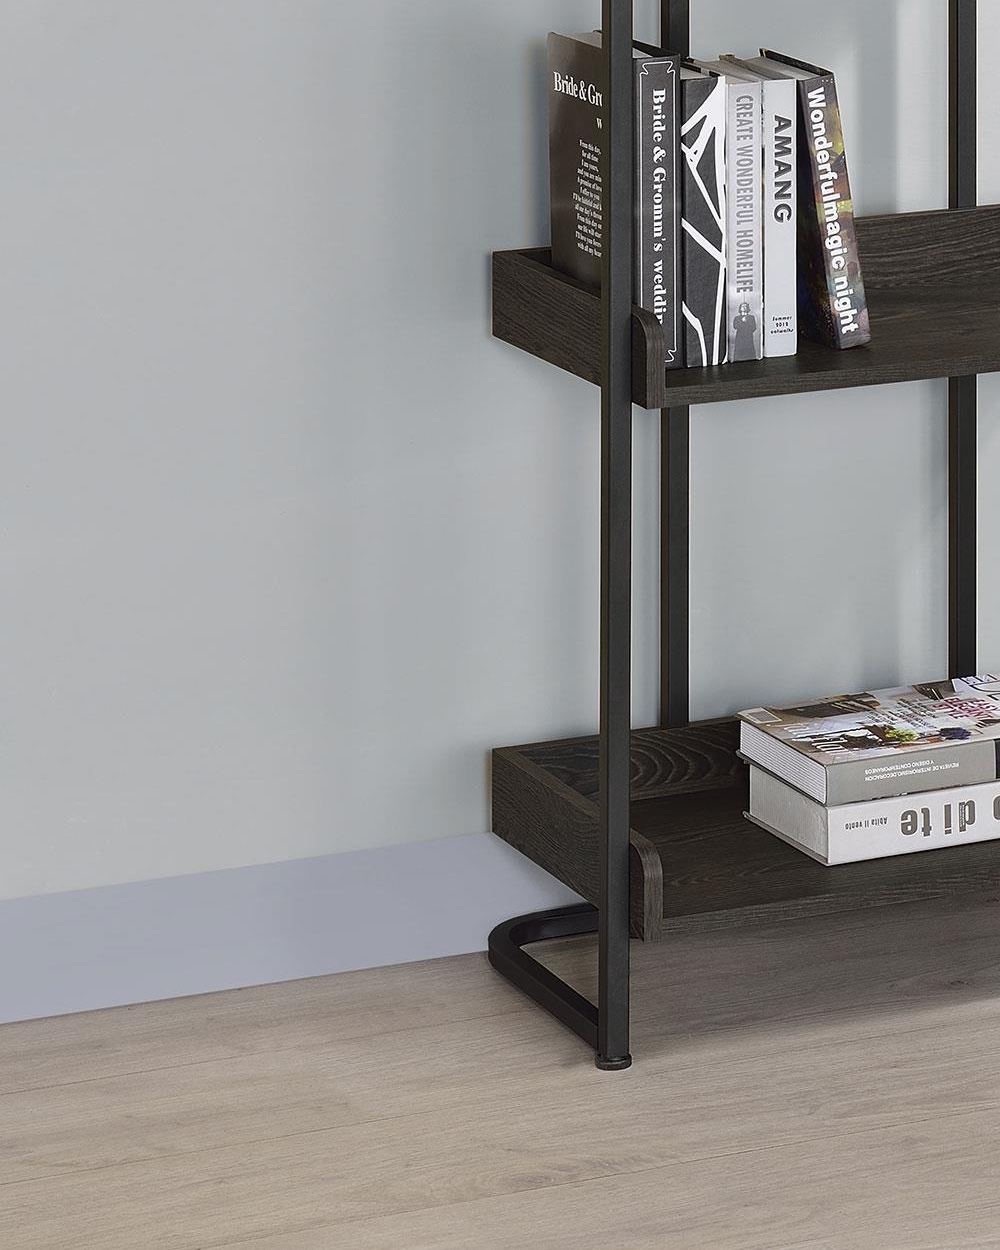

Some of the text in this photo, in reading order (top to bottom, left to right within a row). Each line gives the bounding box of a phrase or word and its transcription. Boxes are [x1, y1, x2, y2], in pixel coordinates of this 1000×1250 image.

[553, 70, 578, 97] Bride
[579, 80, 587, 101] &
[653, 88, 666, 142] Bride
[652, 146, 666, 163] &
[773, 115, 792, 223] AMANG
[652, 166, 667, 252] Gromm's
[736, 95, 754, 293] CREATE WONDERFUL HOMELIFE
[833, 274, 859, 334] night
[845, 819, 863, 831] vento
[871, 815, 888, 826] Abita
[900, 806, 930, 837] te
[944, 800, 976, 835] di
